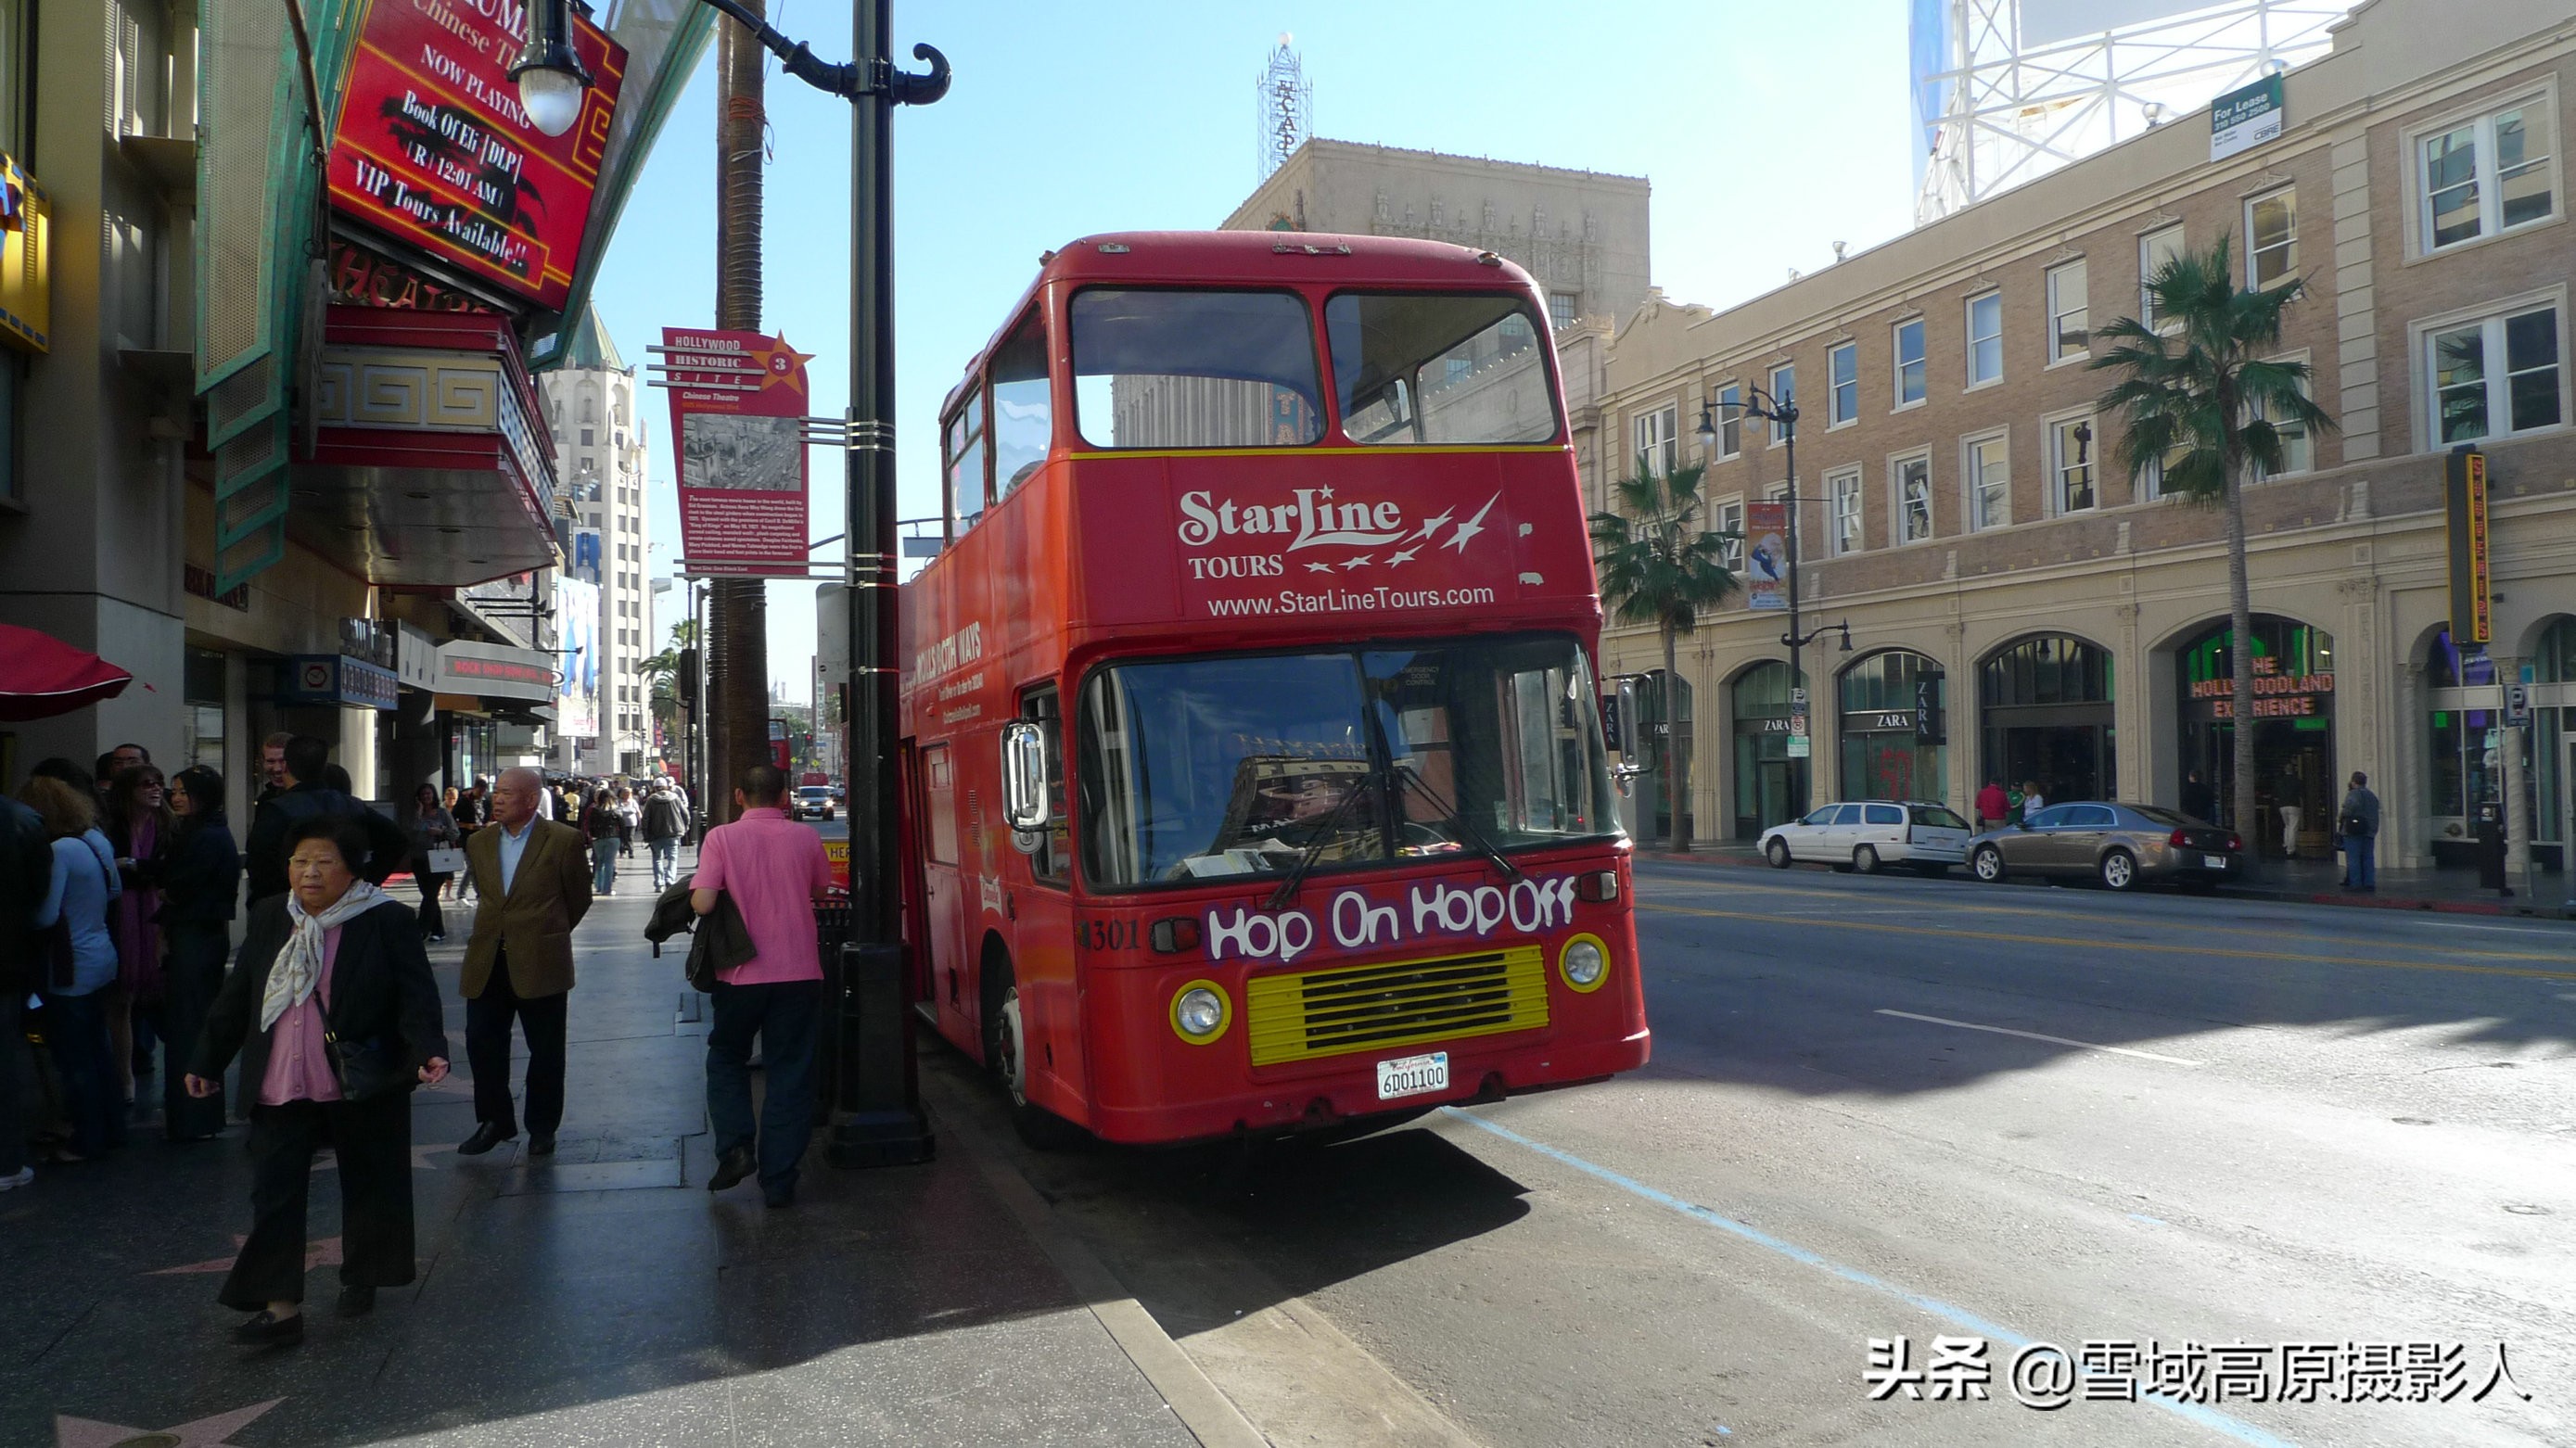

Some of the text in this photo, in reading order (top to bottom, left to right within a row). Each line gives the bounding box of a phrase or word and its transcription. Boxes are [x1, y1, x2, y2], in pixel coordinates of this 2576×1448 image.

[421, 44, 530, 130] NOW PLAYING
[402, 90, 438, 131] Book
[440, 112, 459, 143] Of
[459, 121, 479, 154] Eli
[2213, 93, 2268, 121] For Lease
[437, 157, 472, 190] 12:01
[354, 159, 527, 268] VIP Tours Available!!
[675, 336, 740, 351] HOLLYWOOD
[675, 355, 741, 368] HISTORIC
[775, 357, 786, 370] 3
[673, 372, 742, 385] SITE
[1179, 487, 1409, 553] StarLine
[1188, 554, 1283, 580] TOURS
[1207, 585, 1494, 617] www.StarLineTours.com
[957, 621, 982, 667] WAYS
[1877, 715, 1908, 728] ZARA
[1917, 681, 1929, 735] ZARA
[1765, 719, 1790, 731] ZARA
[1207, 907, 1314, 962] Hop
[1332, 891, 1399, 947] On
[1383, 1067, 1445, 1094] 6D01100
